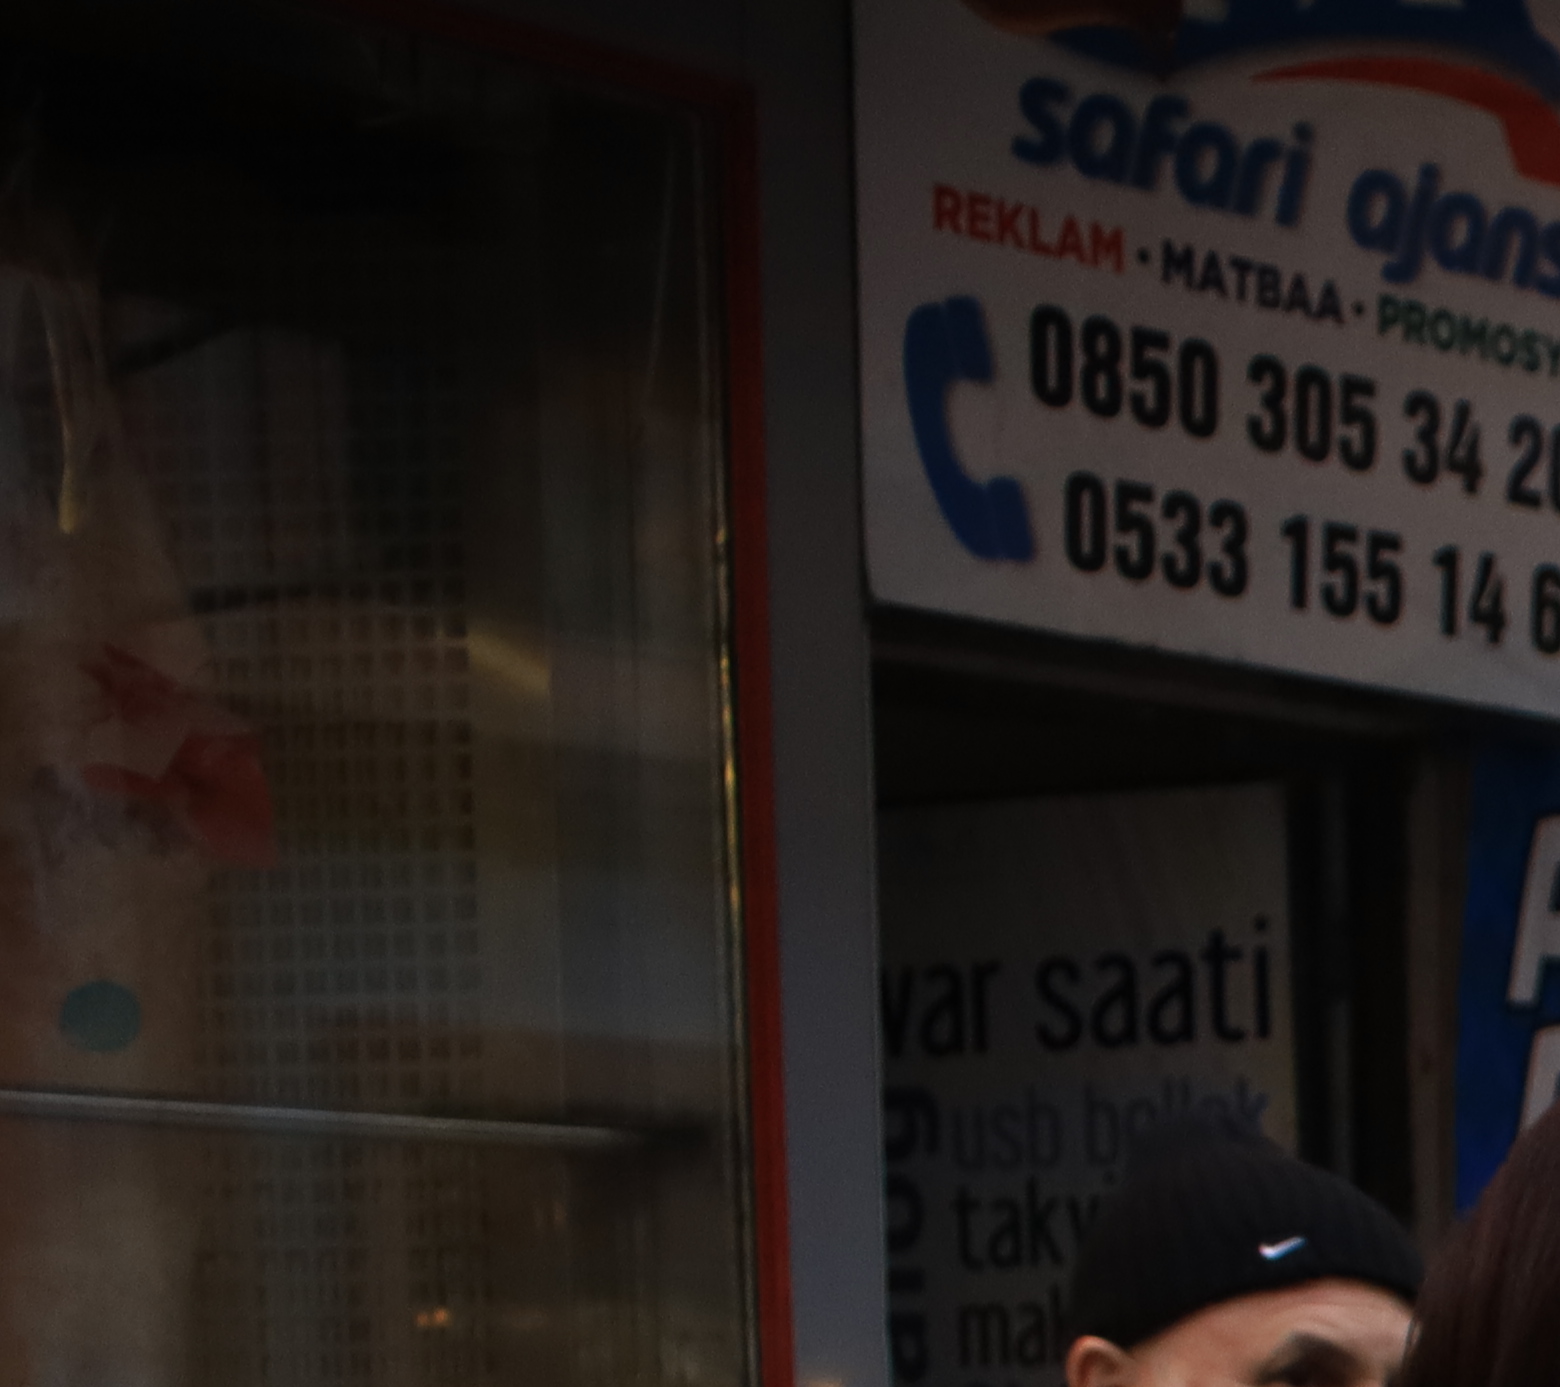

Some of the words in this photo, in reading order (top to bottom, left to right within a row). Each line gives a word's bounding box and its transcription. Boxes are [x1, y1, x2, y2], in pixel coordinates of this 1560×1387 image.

[1012, 76, 1316, 227] safari
[933, 184, 1124, 273] REKLAM
[1161, 240, 1343, 327] MATBAA
[1029, 305, 1220, 439] 0850
[1247, 353, 1377, 473] 305
[1403, 390, 1483, 496] 34
[1064, 470, 1249, 599] 0533
[1280, 513, 1404, 628] 155
[1432, 543, 1506, 647] 14
[1035, 915, 1271, 1049] saati
[952, 1083, 1061, 1170] usb
